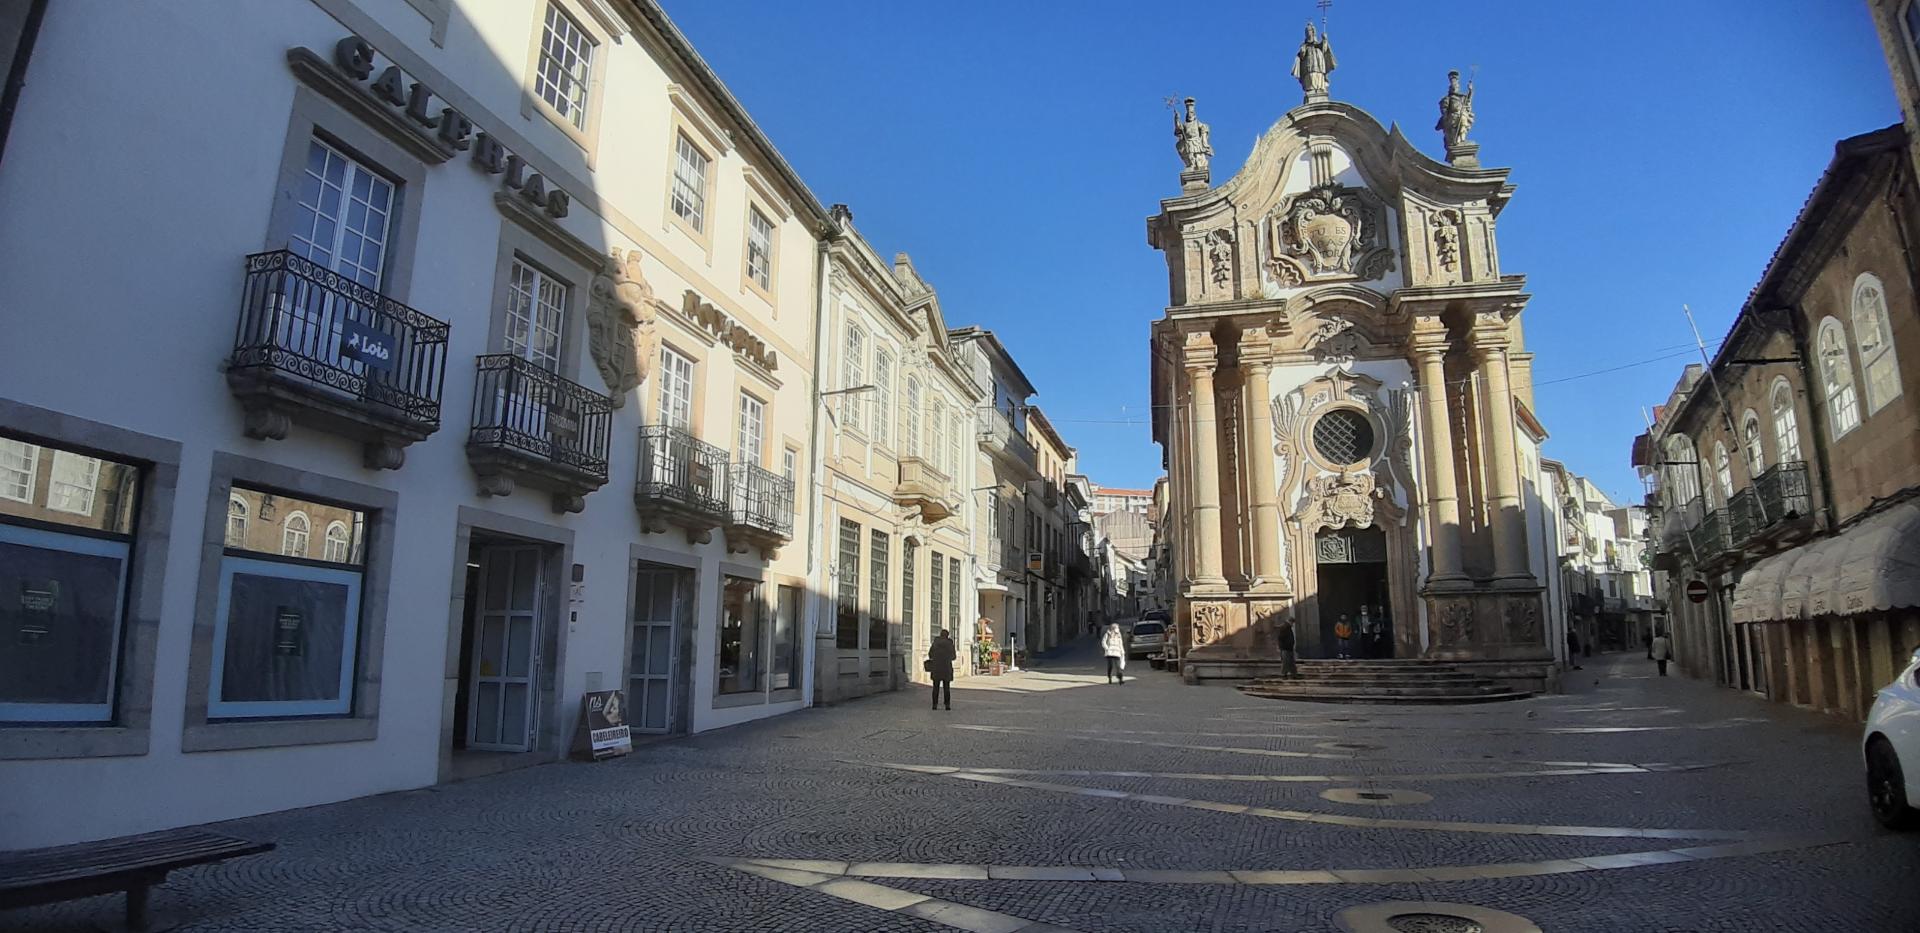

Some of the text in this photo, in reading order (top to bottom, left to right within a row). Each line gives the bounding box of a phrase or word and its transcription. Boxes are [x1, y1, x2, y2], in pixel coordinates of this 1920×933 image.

[336, 36, 569, 218] GALERIAS
[1335, 226, 1346, 235] ES
[361, 335, 389, 360] Lois
